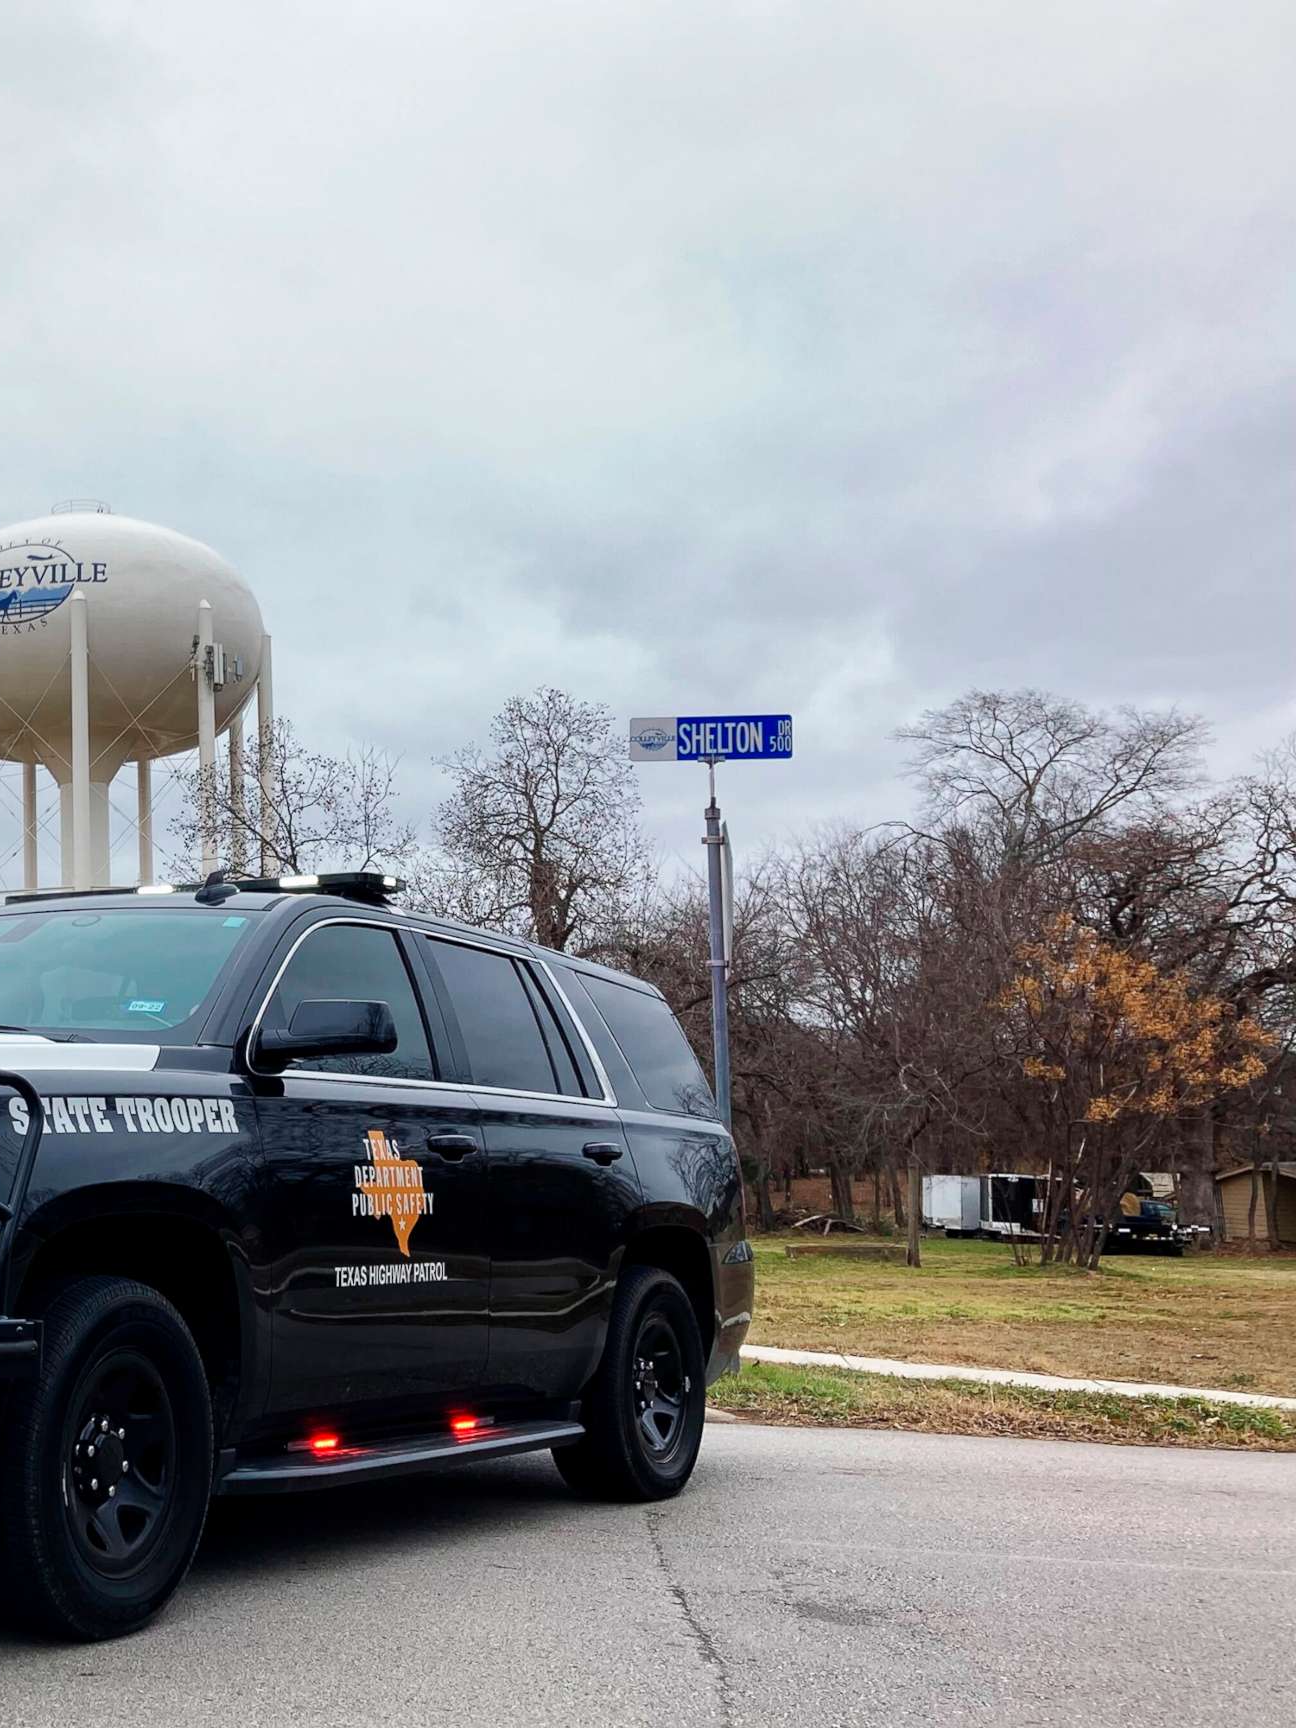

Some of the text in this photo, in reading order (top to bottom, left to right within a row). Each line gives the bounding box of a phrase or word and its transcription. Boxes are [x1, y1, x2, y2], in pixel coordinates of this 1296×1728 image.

[678, 719, 791, 754] SHELTON DR
[769, 735, 792, 752] 500
[117, 1097, 240, 1134] TROOPER
[363, 1139, 400, 1161] TEXAS
[354, 1165, 423, 1188] DEPARTMENT
[352, 1193, 434, 1216] PUBLIC SAFETY
[335, 1262, 448, 1287] TEXAS HIGHWAY PATROL
